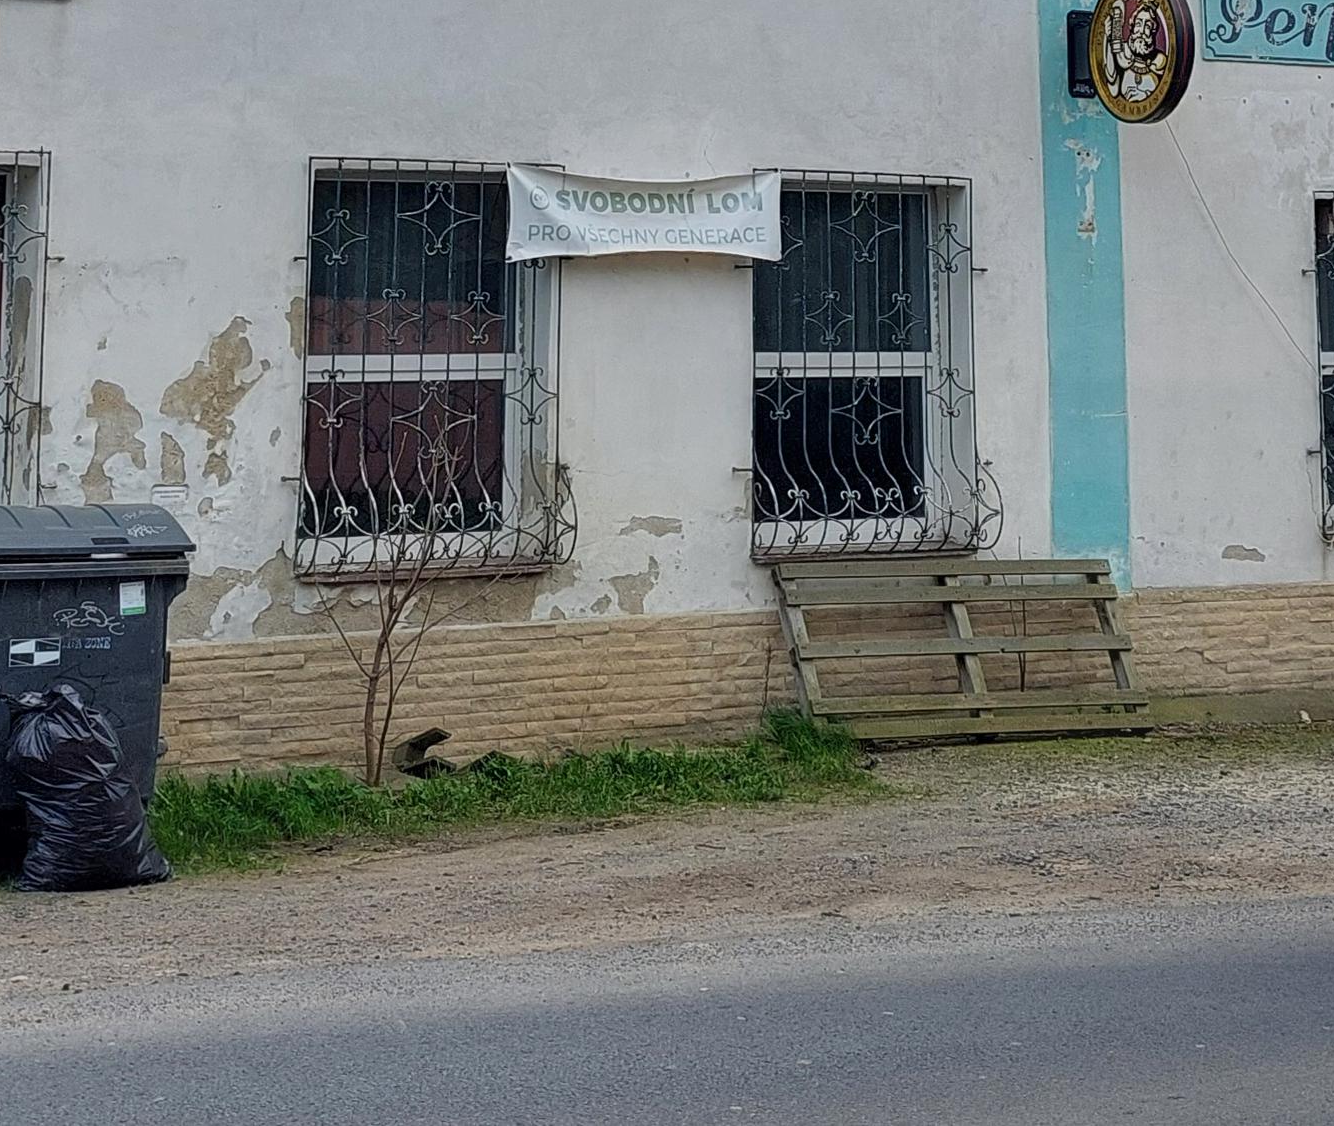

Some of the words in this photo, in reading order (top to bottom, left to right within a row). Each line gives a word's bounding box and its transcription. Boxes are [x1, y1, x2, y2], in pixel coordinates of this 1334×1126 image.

[555, 188, 696, 215] SVOBODNÍ
[706, 190, 764, 213] LOM
[527, 224, 572, 242] PRO
[577, 223, 660, 245] VŠECHNY
[665, 226, 767, 246] GENERACE
